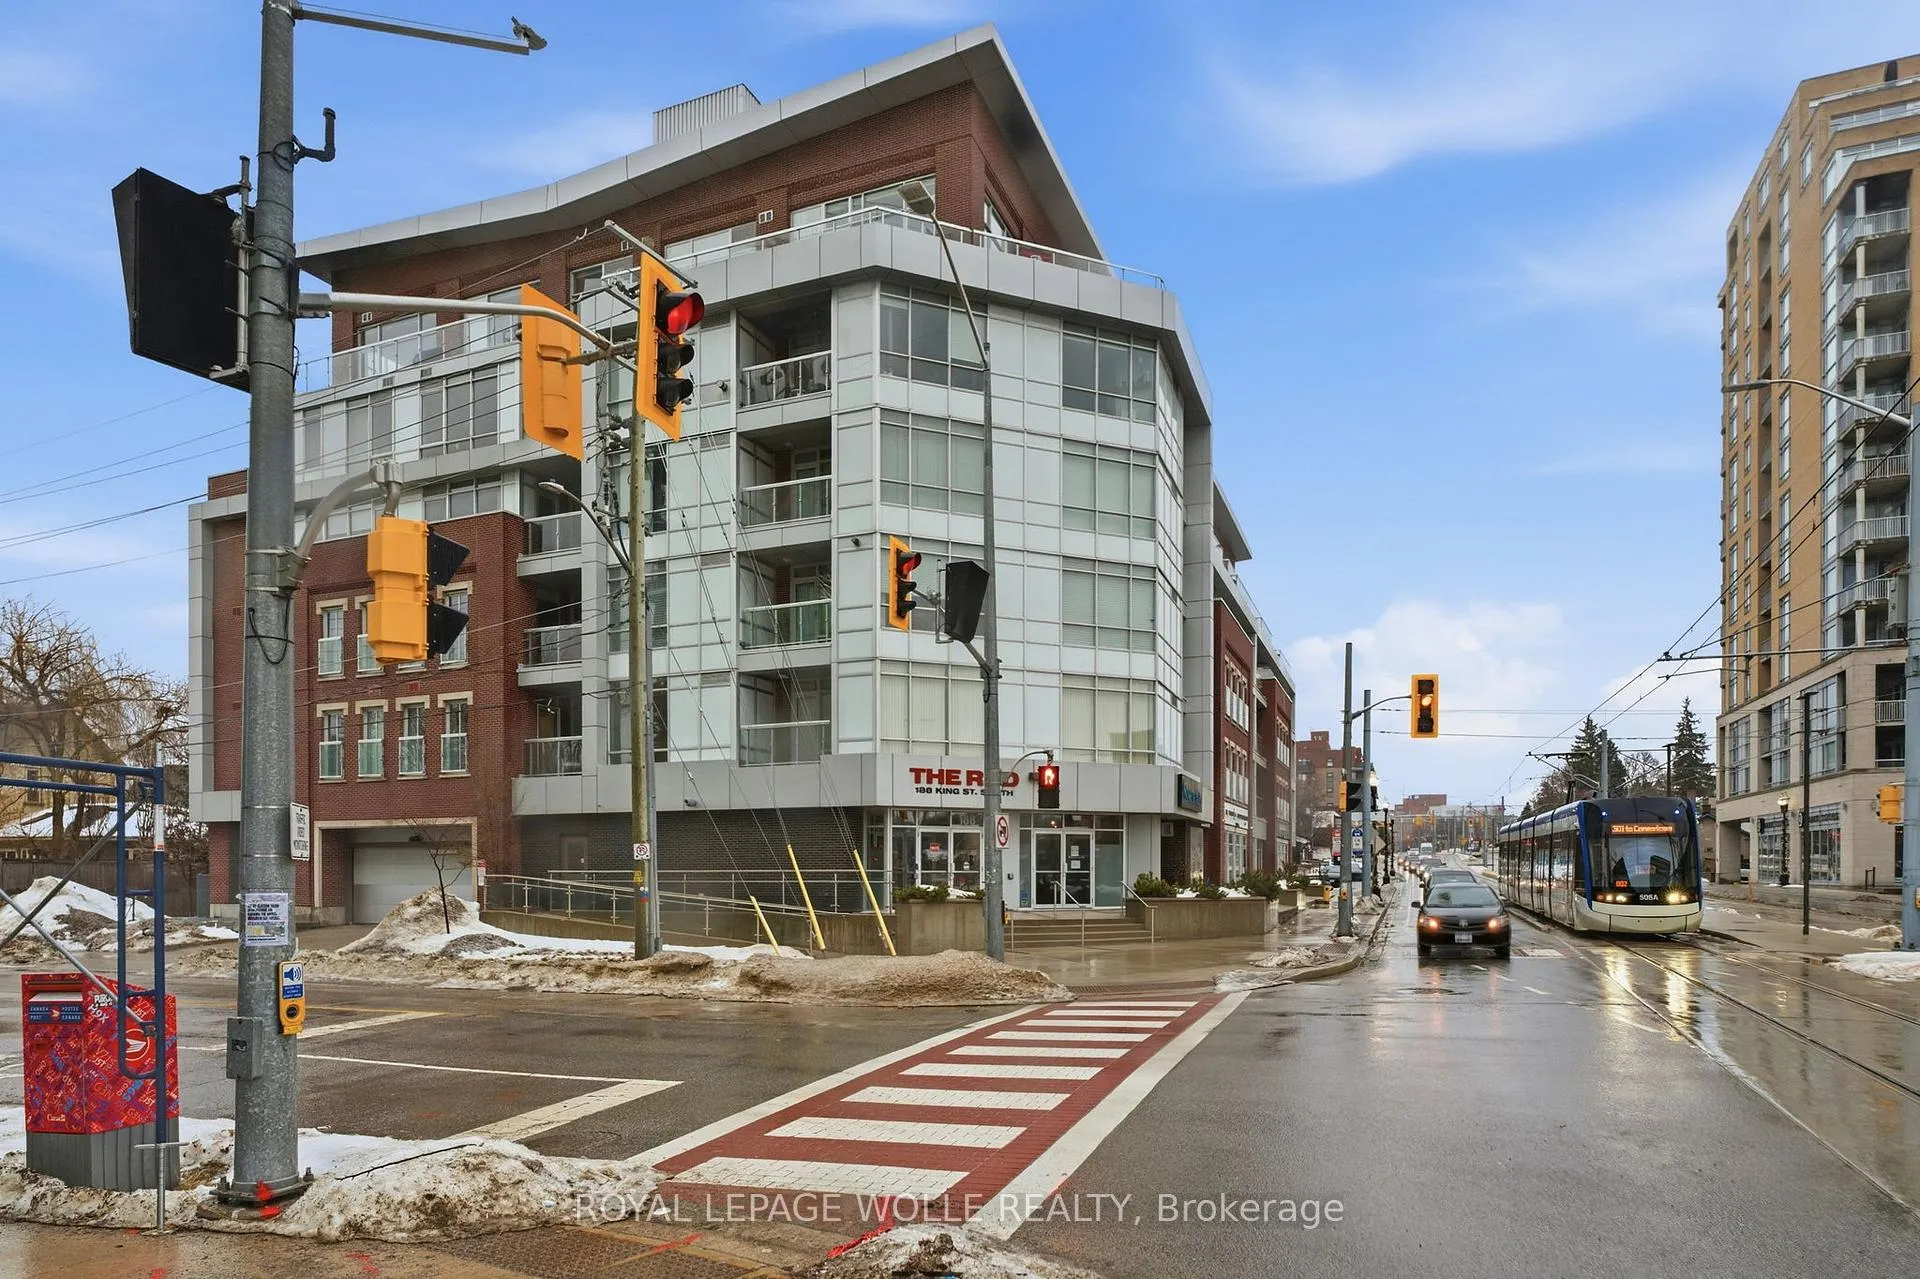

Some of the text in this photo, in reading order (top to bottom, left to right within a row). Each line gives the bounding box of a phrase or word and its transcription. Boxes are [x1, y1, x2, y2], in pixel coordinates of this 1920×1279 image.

[909, 767, 1019, 787] THE RD
[915, 786, 1014, 797] 188 KING ST. STH
[960, 814, 976, 826] 188
